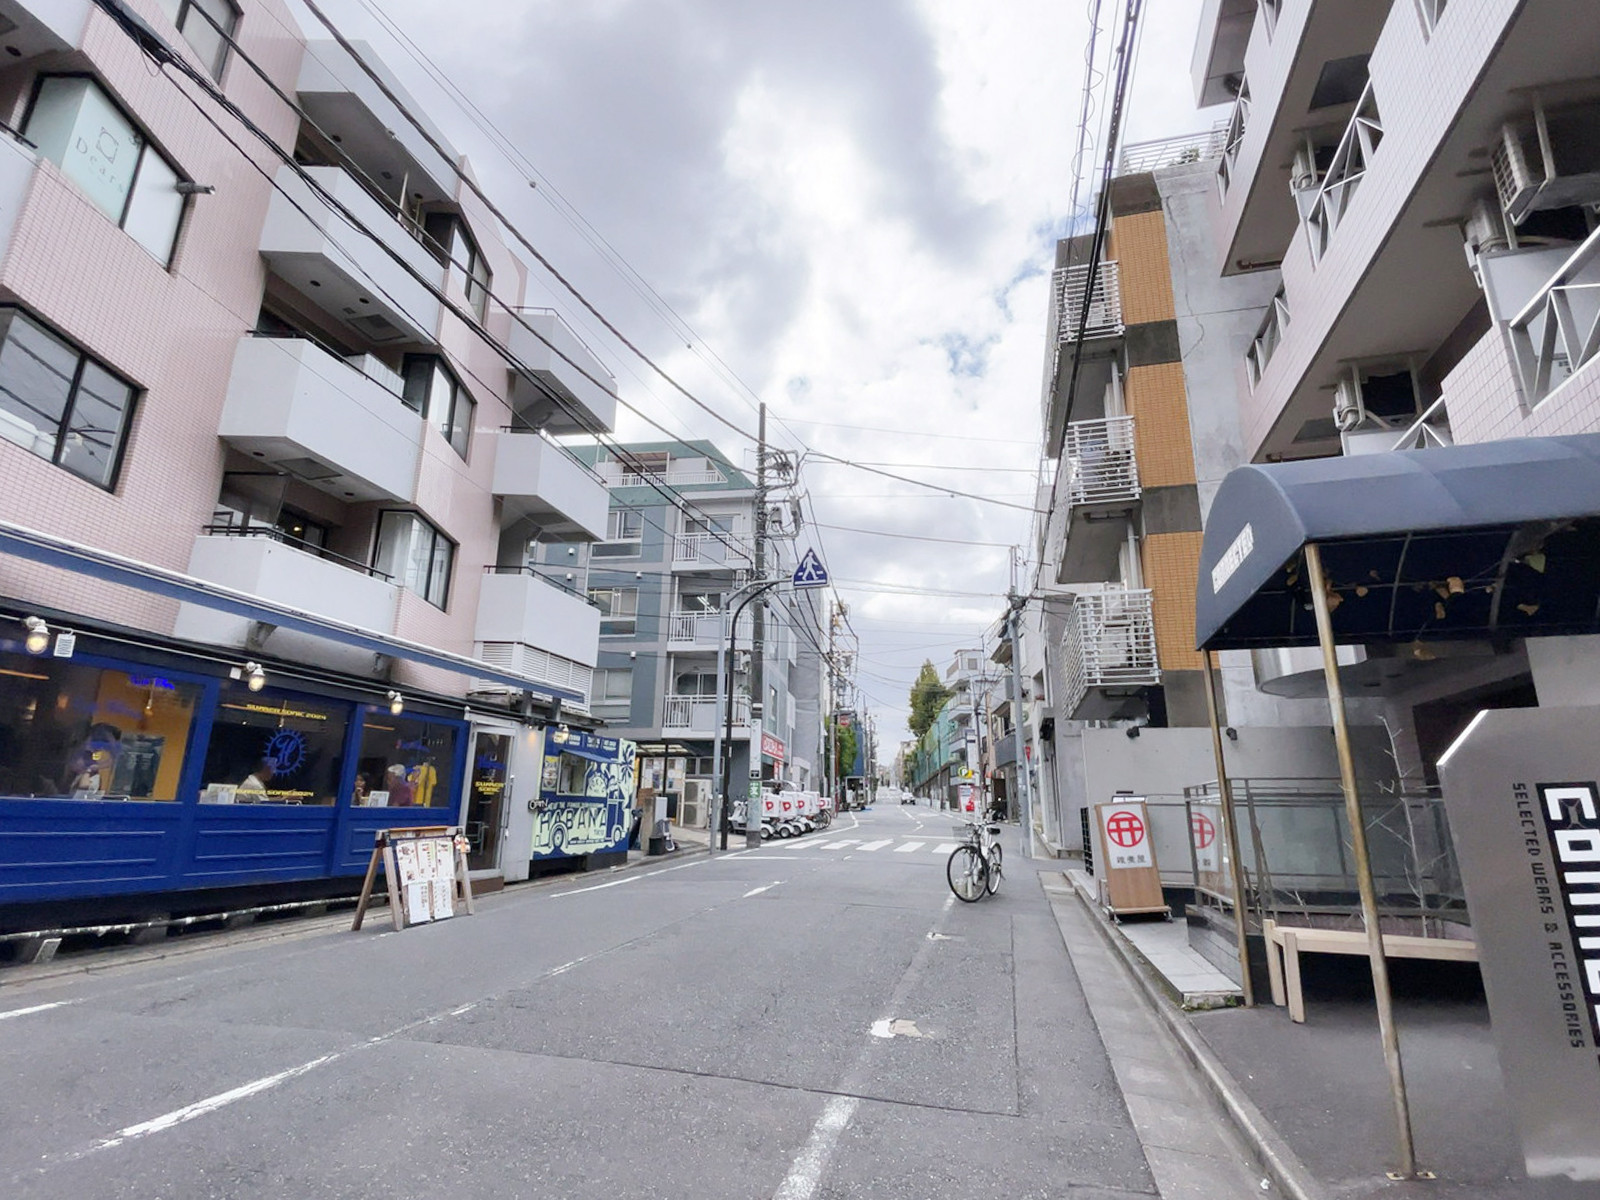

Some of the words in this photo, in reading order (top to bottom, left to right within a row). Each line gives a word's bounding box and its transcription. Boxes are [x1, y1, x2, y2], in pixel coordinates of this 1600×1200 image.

[247, 704, 281, 714] SUMMER
[281, 708, 305, 717] SONIC
[306, 712, 327, 720] 2024
[539, 808, 607, 834] HABANA
[1513, 783, 1540, 856] SELECTED
[1531, 862, 1555, 914] WEARS
[1549, 942, 1585, 1048] ACCESSORIES
